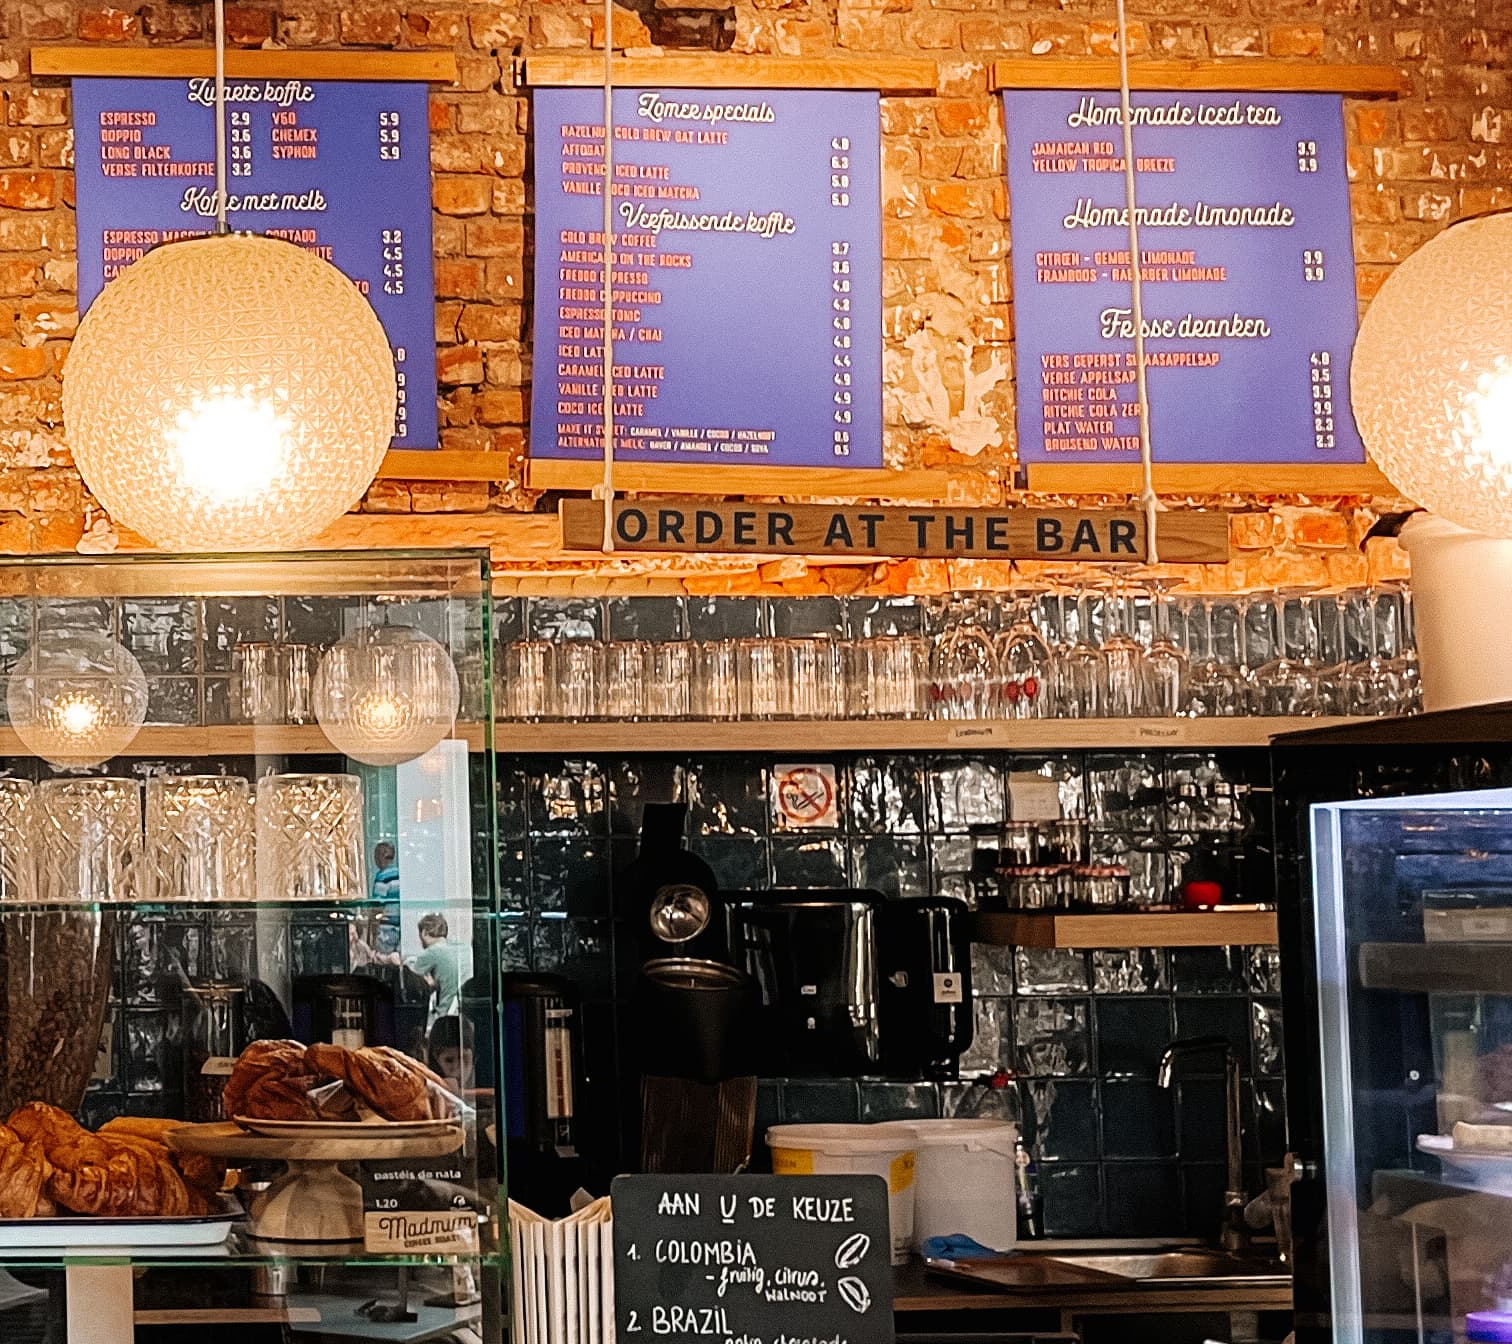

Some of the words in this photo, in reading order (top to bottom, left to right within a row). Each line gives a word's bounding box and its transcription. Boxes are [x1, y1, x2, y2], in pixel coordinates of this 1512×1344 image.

[263, 80, 315, 107] koffie
[638, 93, 701, 123] Zomer
[702, 100, 776, 126] specials
[1198, 101, 1245, 125] iced
[1246, 104, 1281, 125] tea
[100, 112, 156, 126] ESPRESSO
[101, 129, 142, 142] DOPPIO
[272, 128, 317, 142] CHEMEX
[615, 127, 639, 140] COLD
[643, 129, 672, 142] BREW
[698, 131, 728, 145] LATTE
[101, 146, 130, 160] LONG
[134, 146, 171, 160] BLACK
[272, 145, 317, 159] SYPHON
[1032, 142, 1089, 156] JAMAICAN
[1093, 143, 1114, 156] RED
[101, 163, 137, 177] VERSE
[142, 163, 216, 177] FILTERKOFFIE
[615, 164, 637, 177] ICED
[640, 167, 669, 180] LATTE
[1032, 158, 1077, 172] YELLOW
[1136, 158, 1176, 172] BREEZE
[562, 181, 601, 194] VANILLE
[633, 184, 655, 198] ICED
[658, 186, 700, 199] MATCHA
[242, 193, 280, 211] met
[279, 189, 328, 211] melk
[619, 202, 745, 234] Verfrissende
[746, 211, 796, 237] koffie
[1194, 201, 1296, 227] limonade
[103, 230, 158, 244] ESPRESSO
[560, 231, 585, 244] COLD
[621, 234, 656, 247] COFFEE
[620, 253, 634, 265] ON
[638, 253, 655, 266] THE
[659, 255, 691, 268] ROCKS
[1141, 251, 1195, 265] LIMONADE
[560, 268, 596, 282] FREDDO
[1037, 268, 1097, 282] FRAMBOOS
[1172, 268, 1227, 281] LIMONADE
[560, 287, 596, 301] FREDDO
[1178, 313, 1271, 338] dranken
[559, 327, 580, 339] ICED
[639, 329, 662, 341] CHAI
[559, 345, 580, 357] ICED
[1042, 355, 1069, 369] VERS
[1074, 354, 1121, 368] GEPERST
[558, 363, 605, 376] CARAMEL
[634, 366, 664, 379] LATTE
[1042, 371, 1076, 385] VERSE
[1080, 371, 1137, 384] APPELSAP
[558, 382, 598, 396] VANILLE
[628, 385, 657, 398] LATTE
[1043, 388, 1083, 401] RITCHIE
[1088, 388, 1117, 401] COLA
[558, 402, 584, 415] COCO
[614, 404, 643, 416] LATTE
[1044, 405, 1084, 418] RITCHIE
[1089, 405, 1117, 418] COLA
[1044, 421, 1071, 435] PLAT
[1075, 421, 1114, 434] WATER
[1045, 438, 1098, 451] BRUISEND
[1102, 437, 1140, 450] WATER
[616, 508, 794, 547] ORDER
[824, 512, 884, 550] AT
[909, 515, 1010, 553] THE
[1034, 518, 1139, 555] BAR
[658, 1192, 700, 1218] AAN
[720, 1193, 737, 1219] U
[749, 1197, 776, 1218] DE
[792, 1196, 856, 1222] KEUZE
[627, 1243, 641, 1260] 1.
